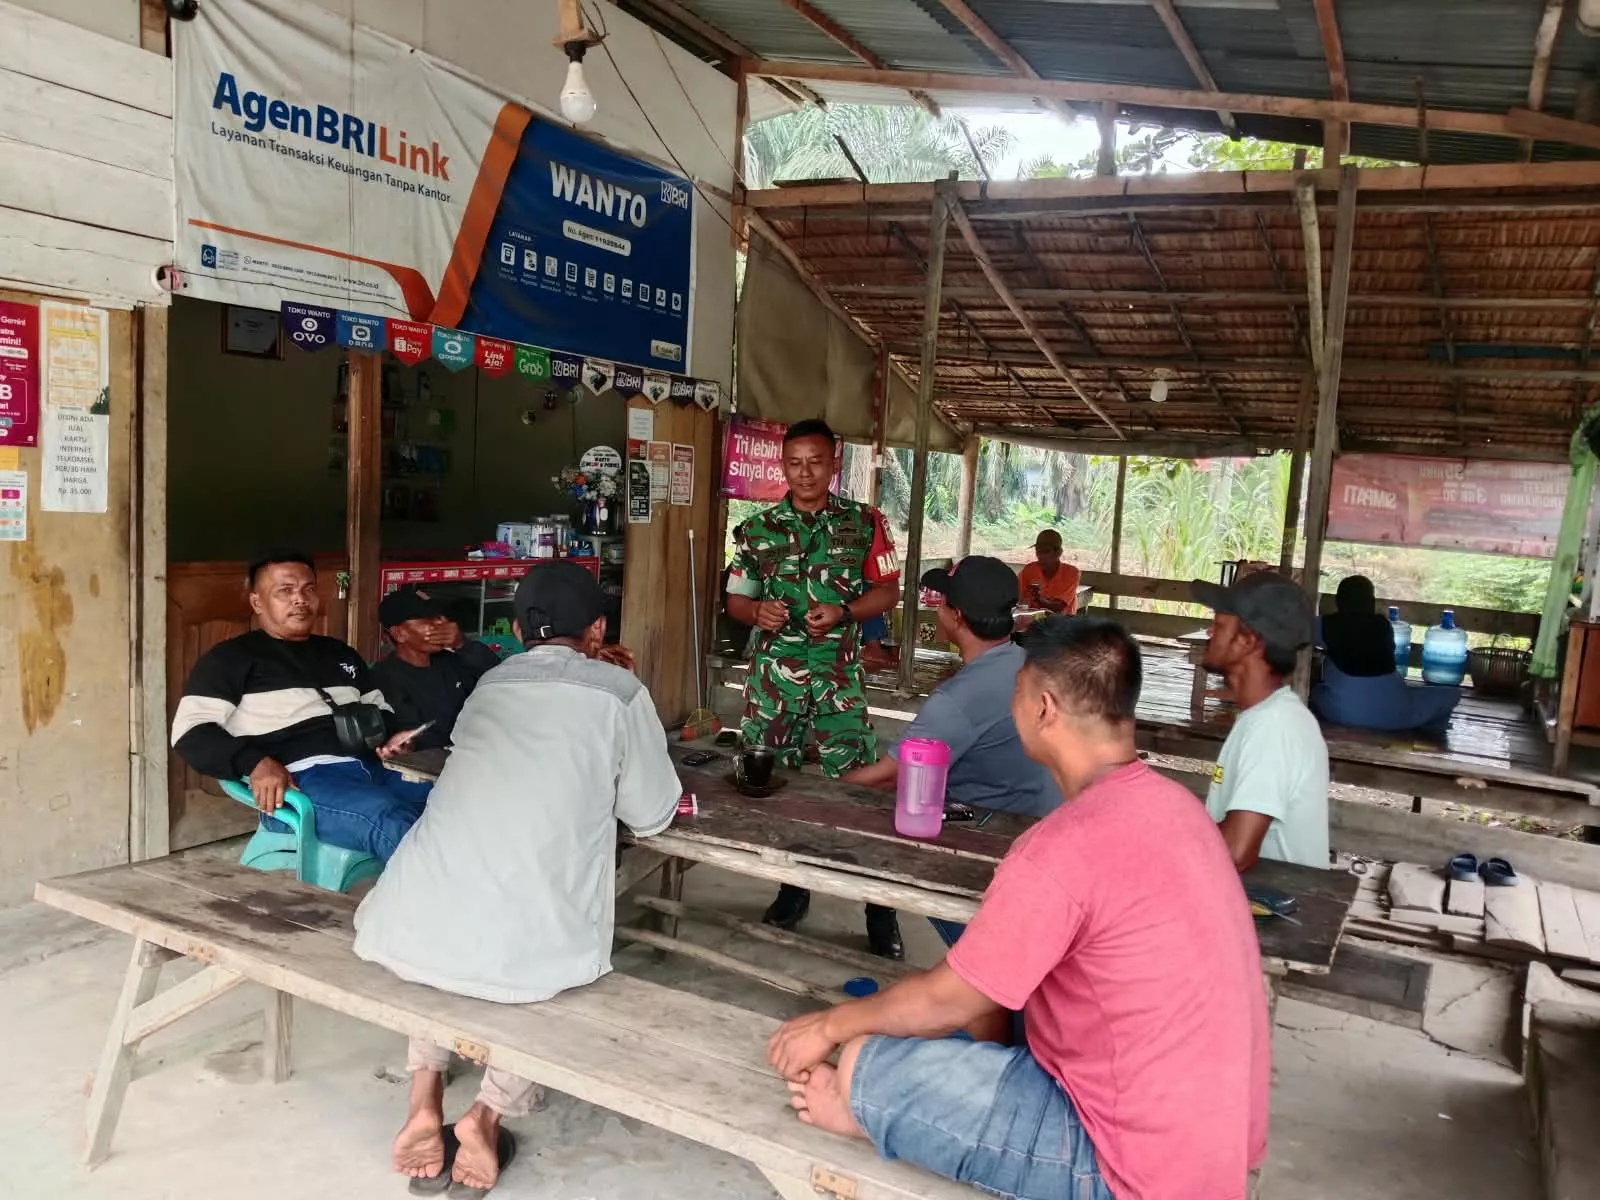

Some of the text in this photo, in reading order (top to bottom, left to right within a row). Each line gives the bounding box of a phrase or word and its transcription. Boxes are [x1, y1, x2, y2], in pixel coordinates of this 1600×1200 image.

[212, 72, 450, 181] AgenBRILink
[211, 121, 451, 203] Layanan Transaksi Keuangan Tanpa Kantor
[549, 160, 647, 228] WANTO
[671, 187, 689, 209] BRI
[287, 306, 331, 319] TOKO WANTO
[341, 314, 380, 327] TOKO WANTO
[392, 323, 428, 335] TOKO WANTO
[293, 331, 326, 344] OVO
[407, 344, 423, 358] Pay
[438, 352, 467, 363] gopay
[484, 350, 505, 361] Link
[519, 359, 544, 376] Grab
[563, 363, 579, 379] BRI
[626, 375, 642, 389] BRI
[680, 384, 694, 397] BRI
[64, 435, 87, 443] KARTU
[60, 446, 92, 454] INTERNET
[734, 433, 777, 459] Tri lebih
[56, 455, 95, 464] TELKOMSEL
[766, 465, 786, 486] cep
